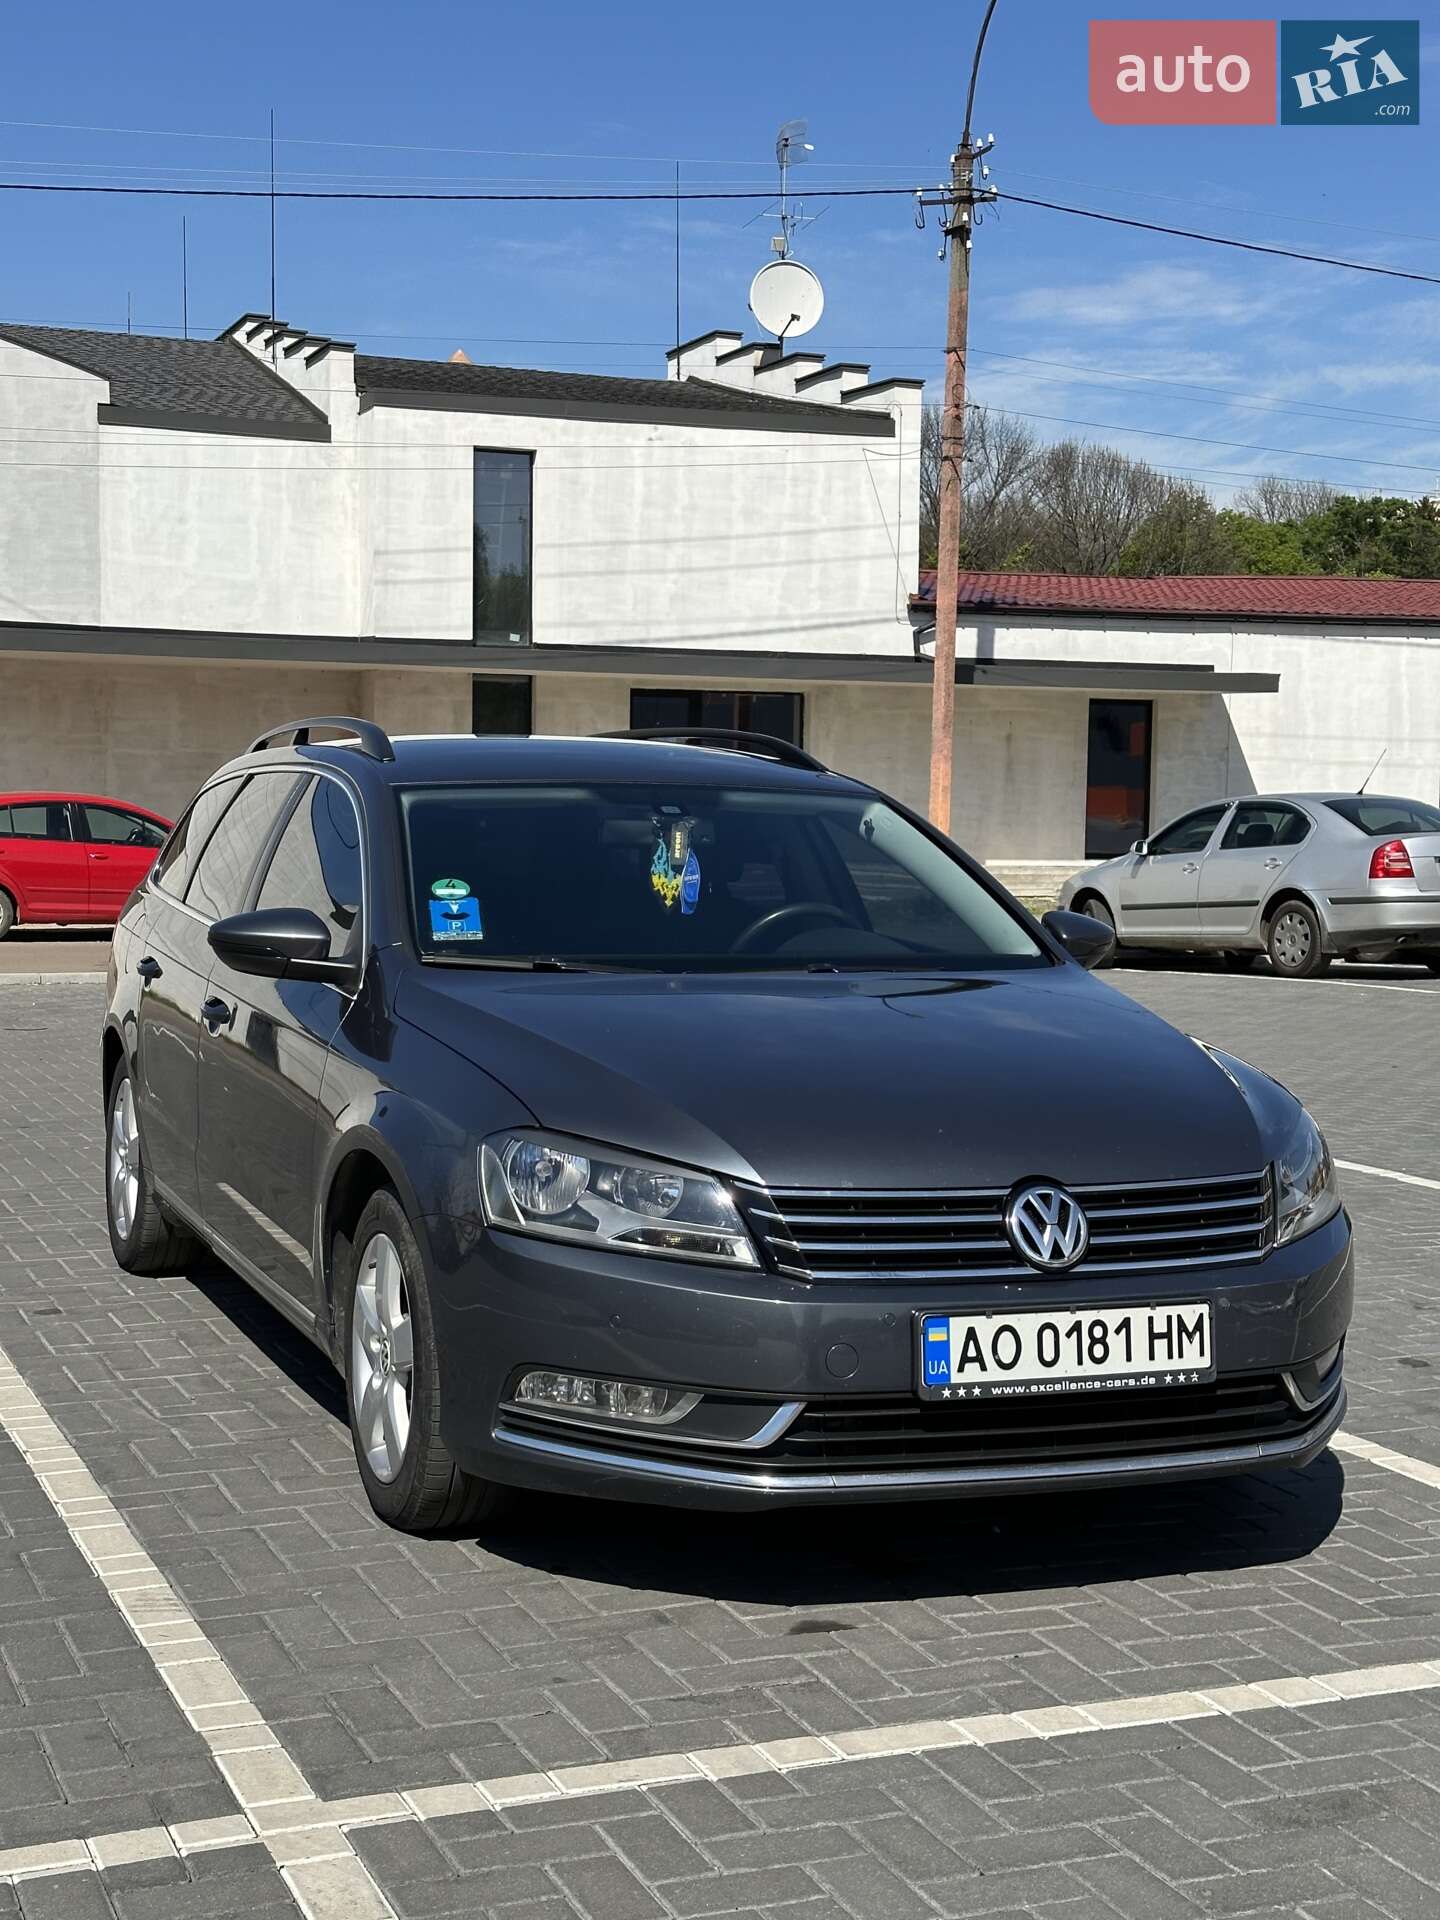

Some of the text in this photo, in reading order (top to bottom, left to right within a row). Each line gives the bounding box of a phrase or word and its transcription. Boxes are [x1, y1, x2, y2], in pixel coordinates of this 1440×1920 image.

[452, 921, 462, 930] P
[957, 1312, 1205, 1373] AO 0181 HM
[929, 1360, 949, 1374] UA
[991, 1375, 1156, 1395] www.excellence-cars.de
